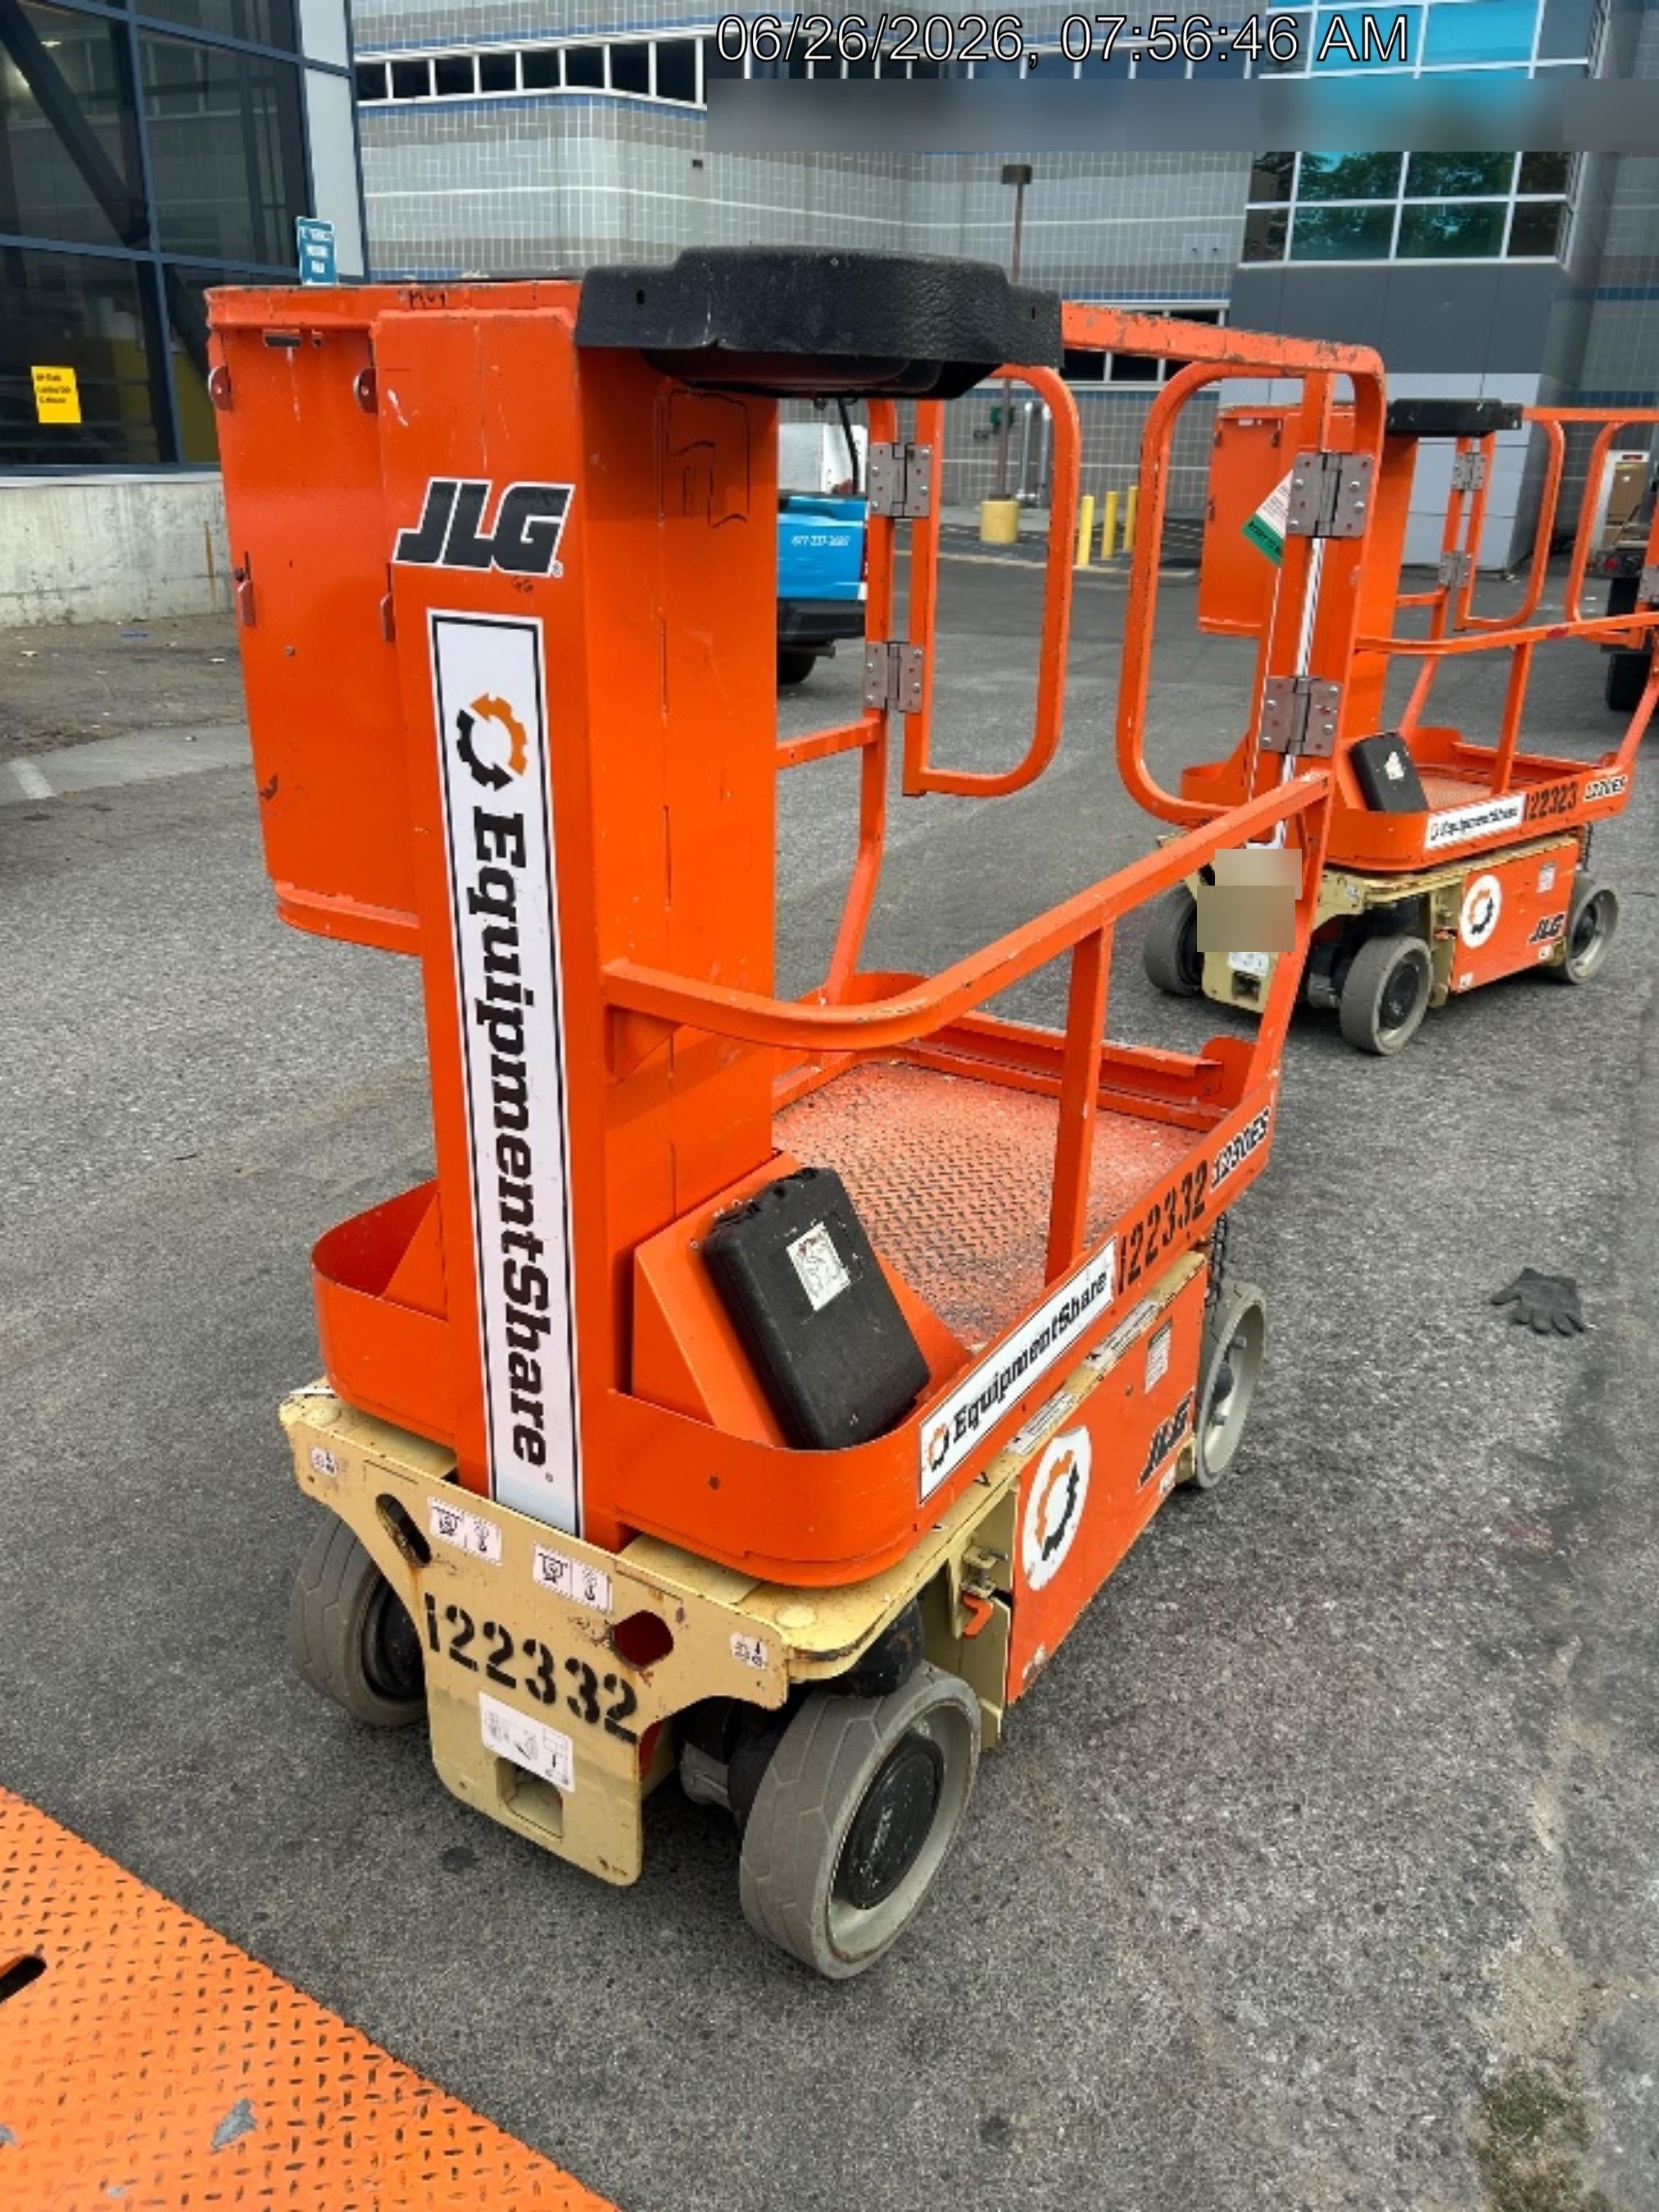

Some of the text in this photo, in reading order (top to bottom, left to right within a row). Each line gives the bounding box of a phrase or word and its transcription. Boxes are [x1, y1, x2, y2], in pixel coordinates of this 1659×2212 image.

[392, 477, 575, 578] JLG
[1524, 781, 1578, 820] 122323
[1528, 912, 1566, 944] JLG
[466, 805, 553, 1467] EquipmentShare
[1117, 1159, 1208, 1295] 122332
[953, 1271, 1107, 1444] EquipmentShare
[1137, 1387, 1195, 1491] JLG
[424, 1591, 638, 1745] 122332
